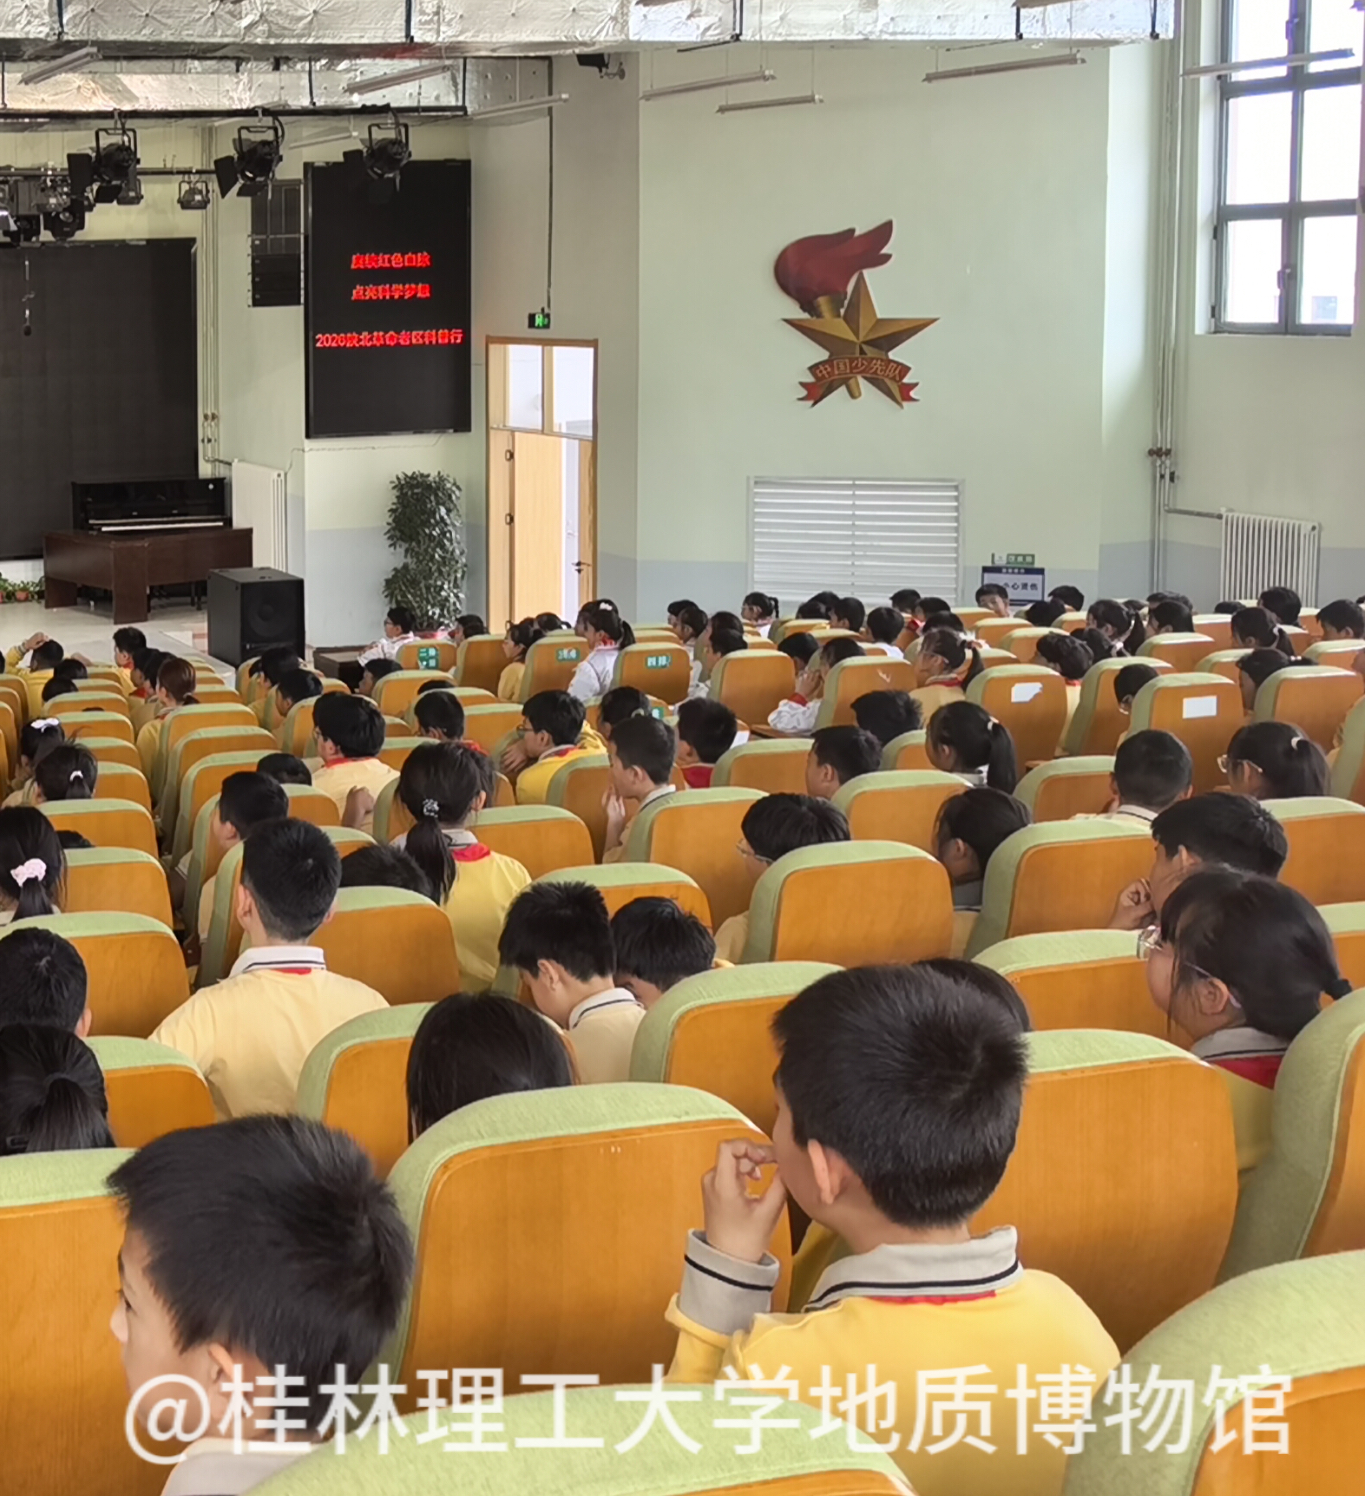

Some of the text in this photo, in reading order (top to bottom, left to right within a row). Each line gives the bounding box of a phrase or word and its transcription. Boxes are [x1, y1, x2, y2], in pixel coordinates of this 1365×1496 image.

[351, 283, 430, 301] 点亮科学梦想
[815, 358, 902, 381] 中国少先队
